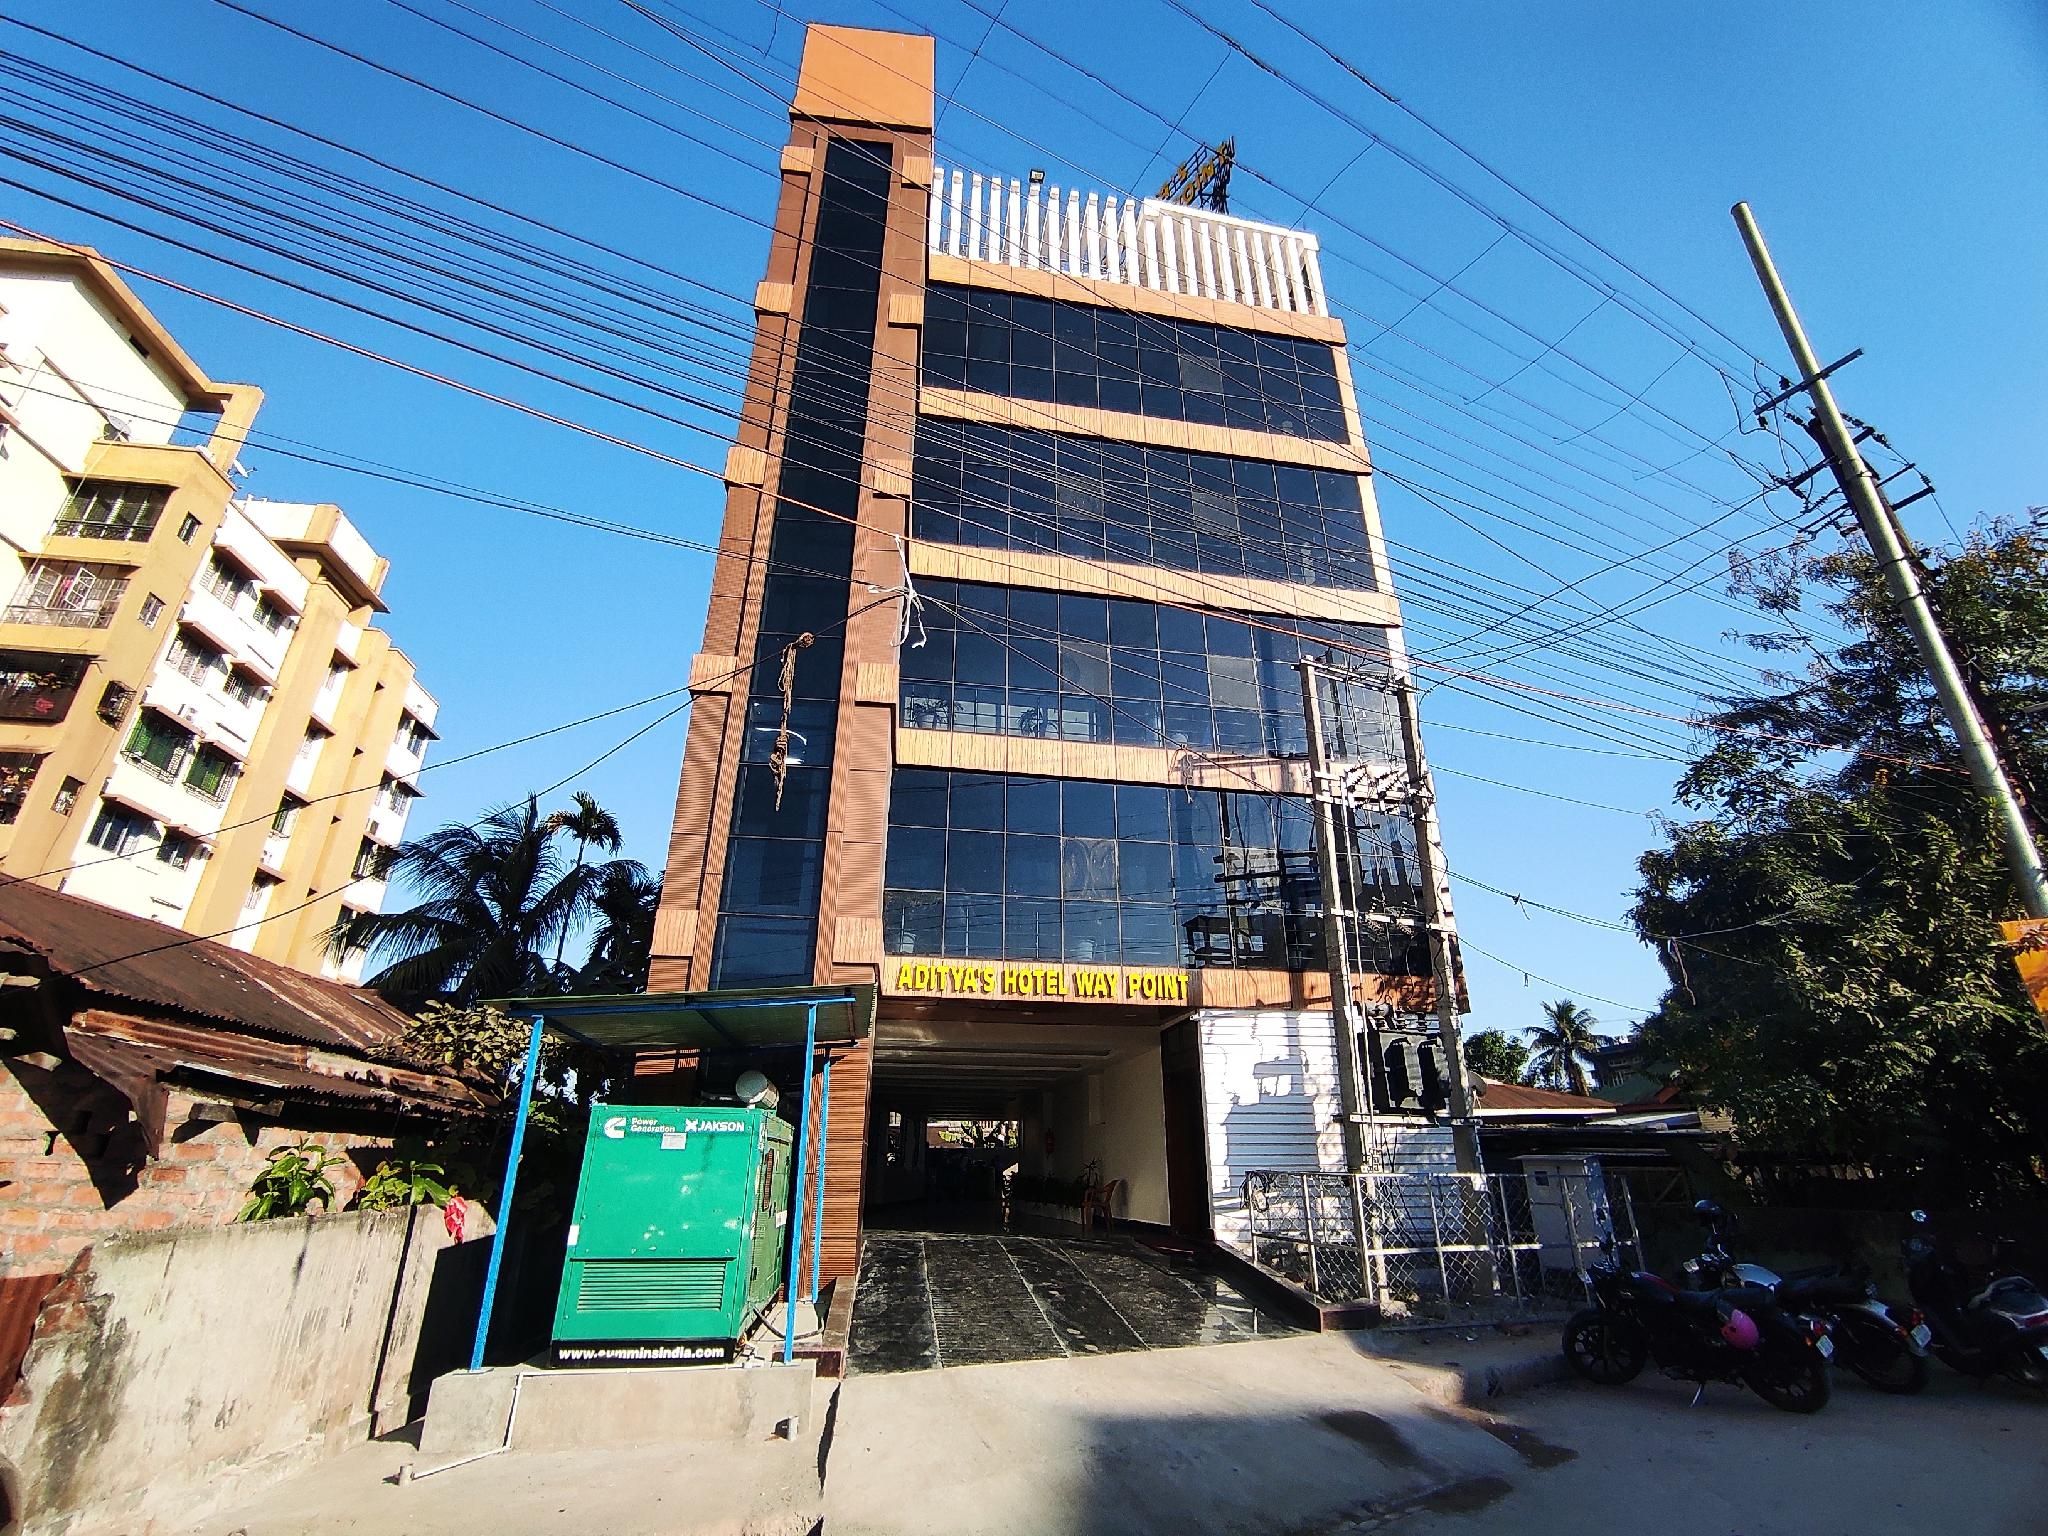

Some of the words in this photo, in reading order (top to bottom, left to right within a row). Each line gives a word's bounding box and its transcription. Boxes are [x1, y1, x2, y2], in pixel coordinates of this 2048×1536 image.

[896, 963, 996, 993] ADITYA'S
[1003, 966, 1070, 996] HOTEL
[1075, 970, 1119, 998] WAY
[1126, 974, 1189, 999] POINT
[631, 1117, 659, 1126] Power
[630, 1124, 676, 1133] Generation
